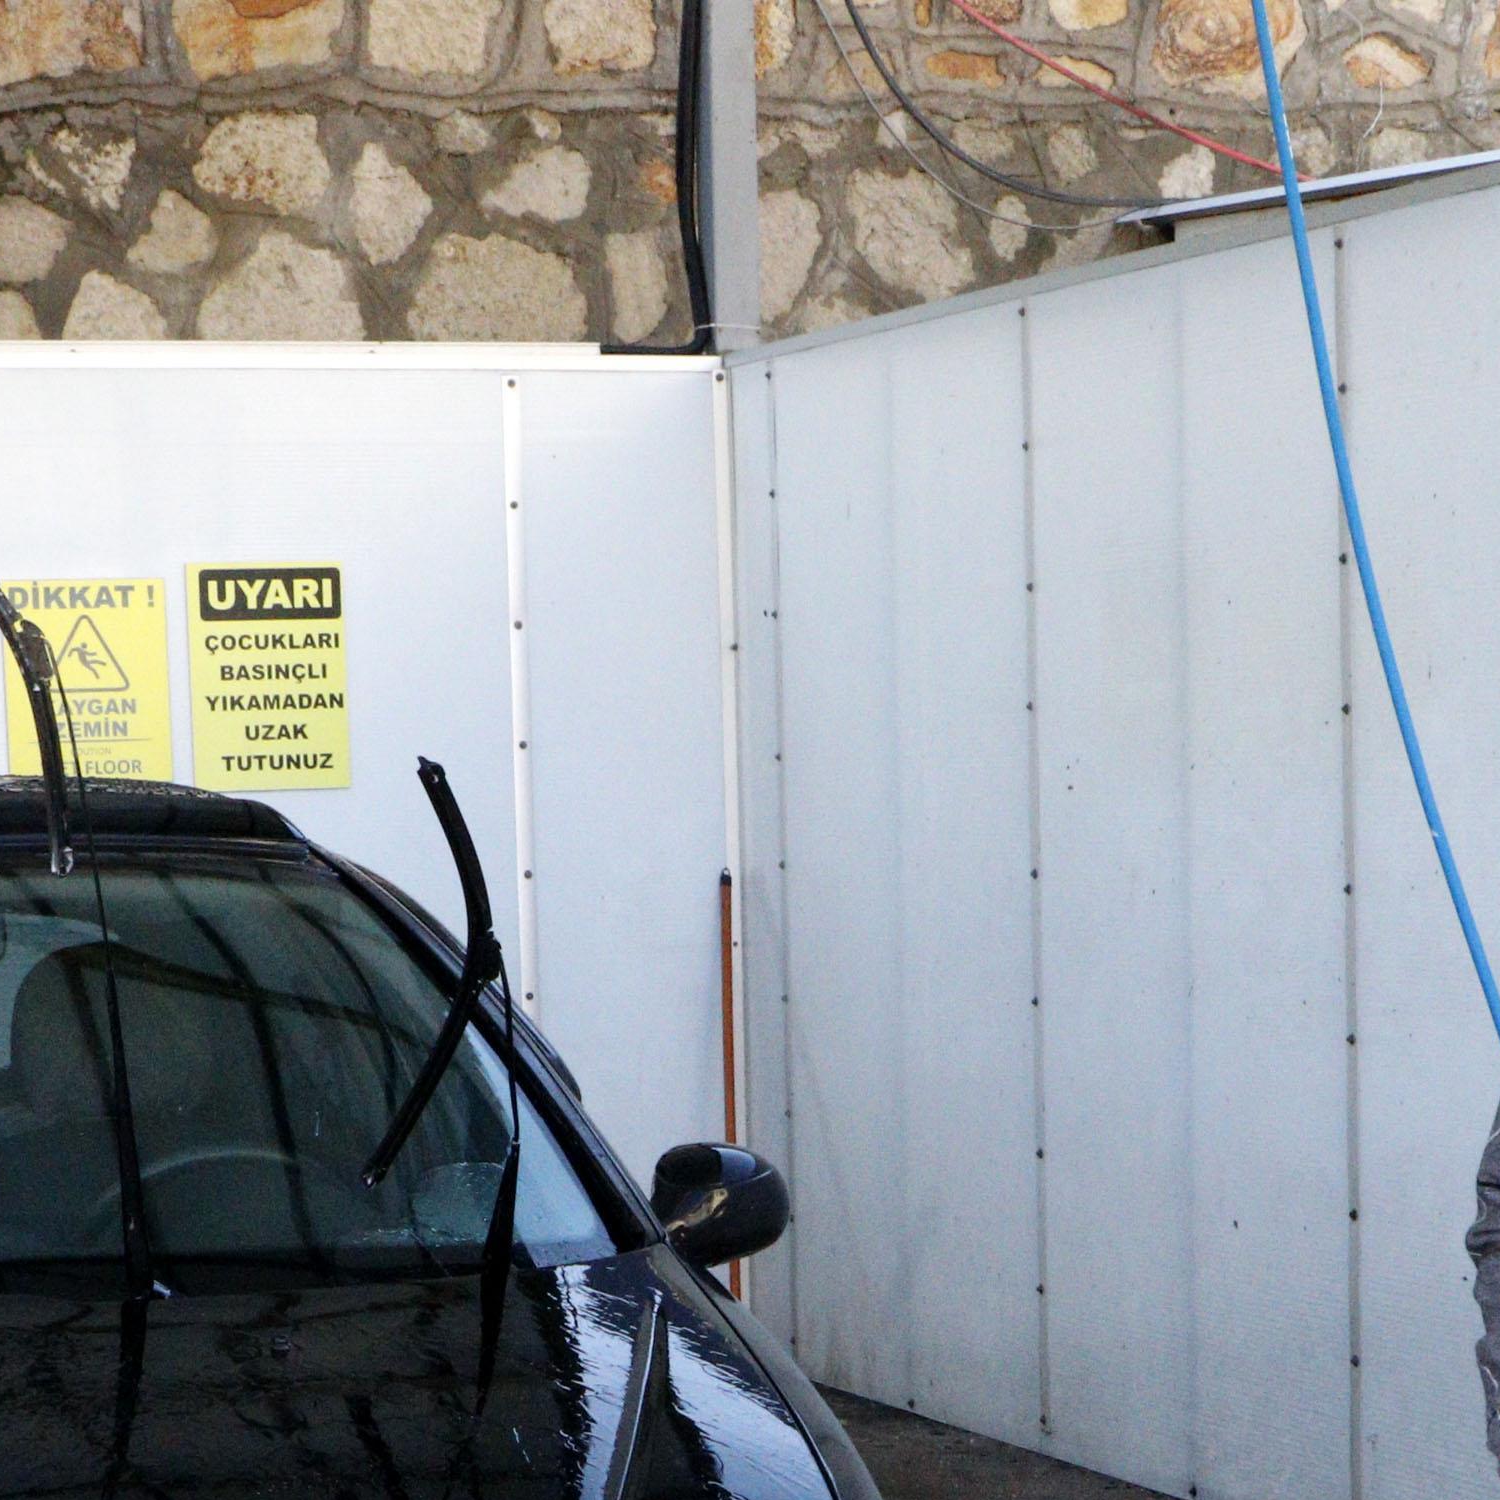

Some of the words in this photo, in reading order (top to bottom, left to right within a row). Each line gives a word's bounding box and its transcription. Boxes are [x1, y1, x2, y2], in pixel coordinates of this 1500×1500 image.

[8, 580, 135, 609] DİKKAT
[207, 578, 333, 610] UYARI
[205, 633, 339, 654] ÇOCUKLARI
[220, 663, 327, 683] BASINÇLI
[57, 698, 137, 716] AYGAN
[205, 693, 344, 711] YIKAMADAN
[245, 724, 308, 740] UZAK
[85, 760, 143, 775] FLOOR
[222, 753, 333, 771] TUTUNUZ
